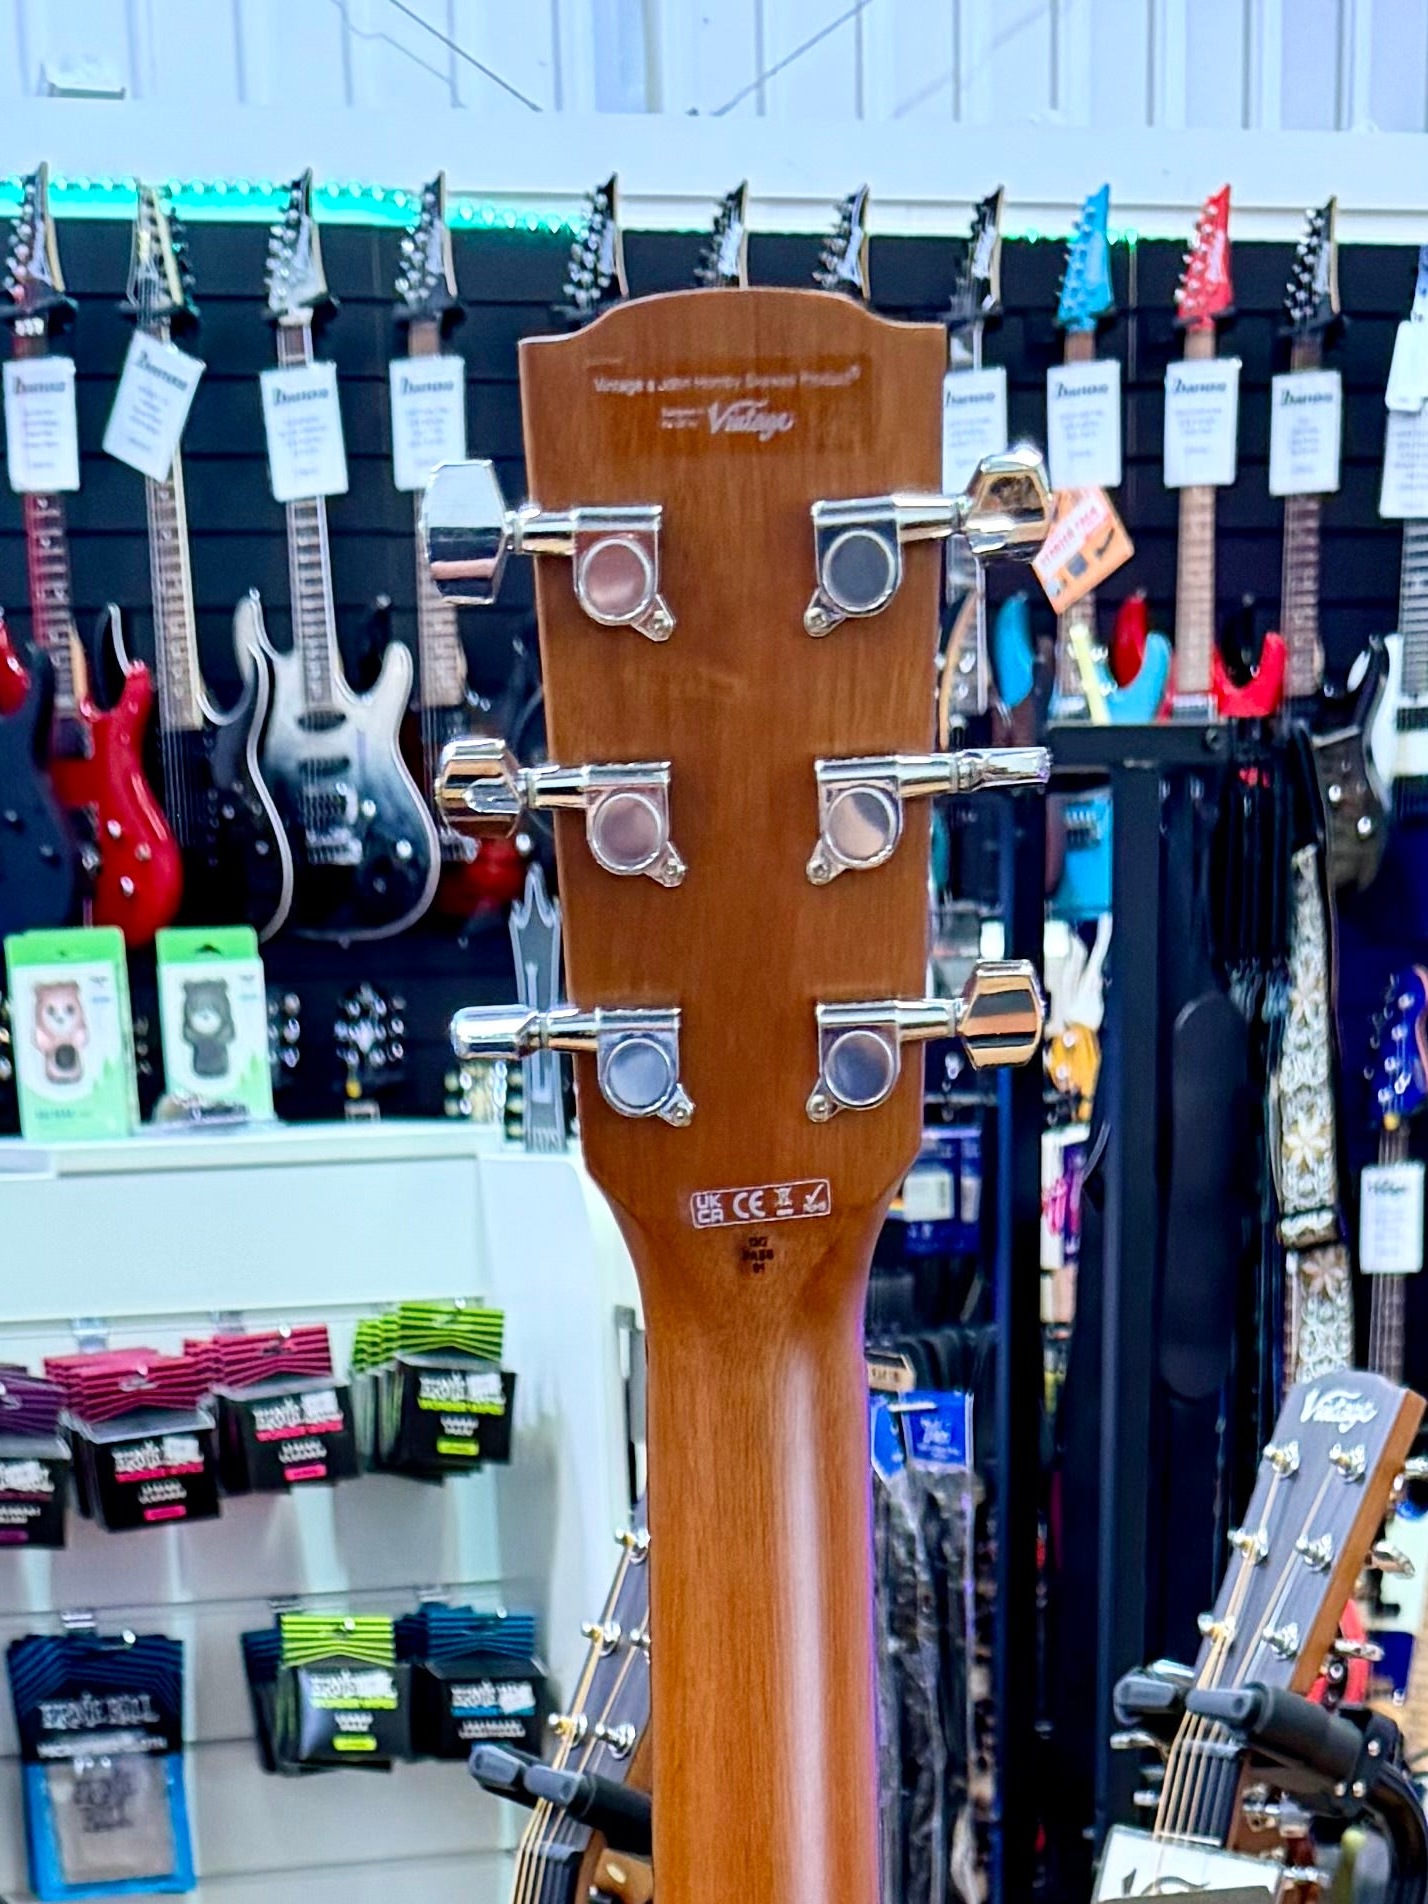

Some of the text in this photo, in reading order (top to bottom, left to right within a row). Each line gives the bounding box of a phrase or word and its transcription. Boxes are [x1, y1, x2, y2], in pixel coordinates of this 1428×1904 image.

[707, 398, 794, 442] Vintage
[696, 1194, 721, 1209] UK
[697, 1208, 724, 1224] CA
[732, 1190, 766, 1219] CE
[39, 1692, 159, 1729] ERNIE BALL
